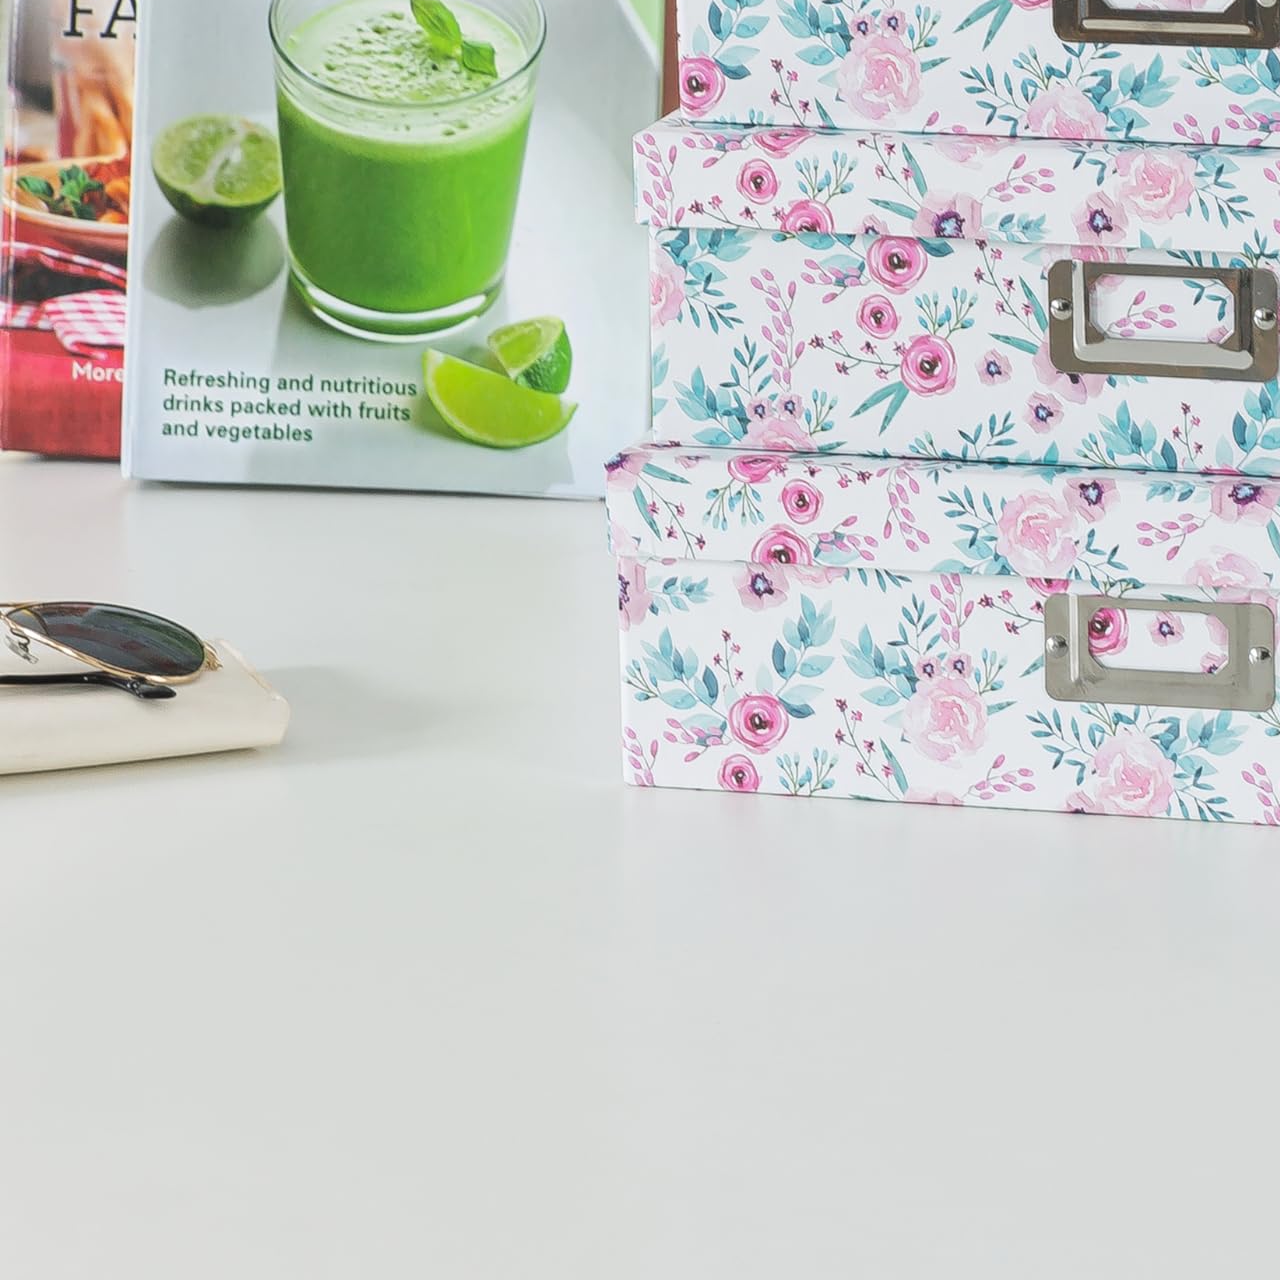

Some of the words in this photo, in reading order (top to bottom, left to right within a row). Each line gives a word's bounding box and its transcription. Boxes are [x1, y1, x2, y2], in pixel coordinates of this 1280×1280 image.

[163, 367, 271, 394] Refreshing
[276, 373, 314, 393] and
[320, 375, 418, 397] nutritious
[162, 393, 224, 414] drinks
[230, 398, 302, 417] packed
[307, 399, 353, 420] with
[358, 401, 412, 422] fruits
[161, 419, 199, 438] and
[205, 422, 314, 443] vegetables
